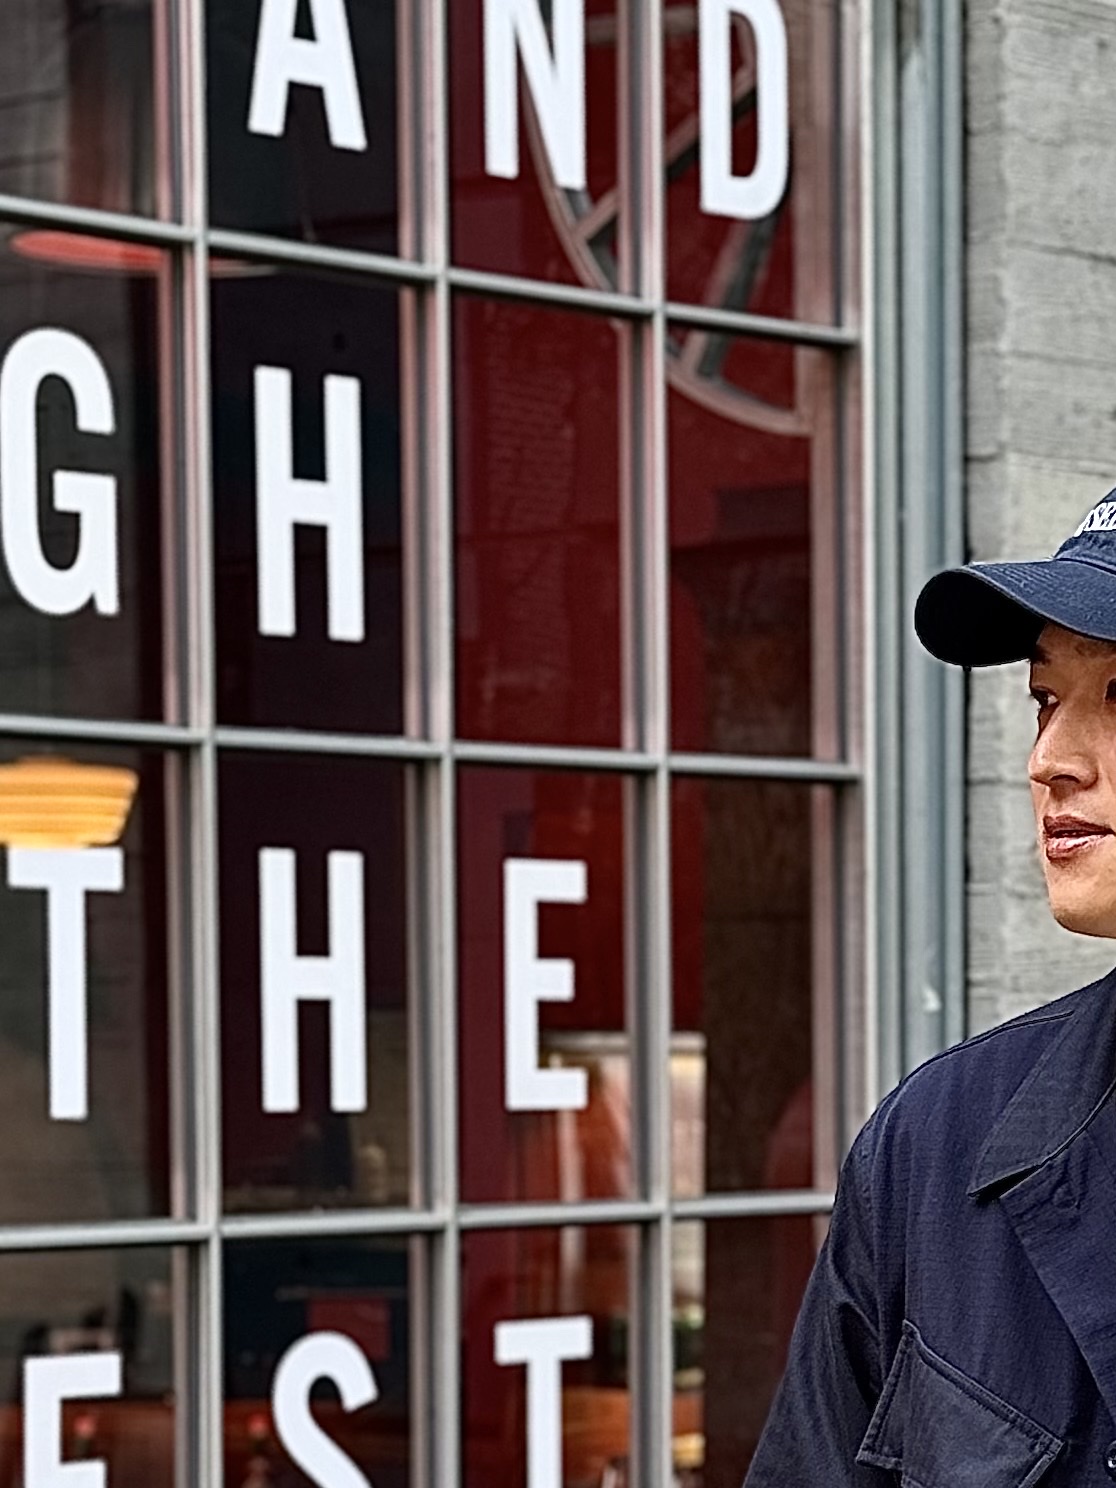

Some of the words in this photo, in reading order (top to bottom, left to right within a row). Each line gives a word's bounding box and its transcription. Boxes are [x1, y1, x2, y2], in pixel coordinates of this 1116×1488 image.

[248, 0, 789, 220] AND
[0, 327, 365, 642] GH
[7, 846, 588, 1120] THE
